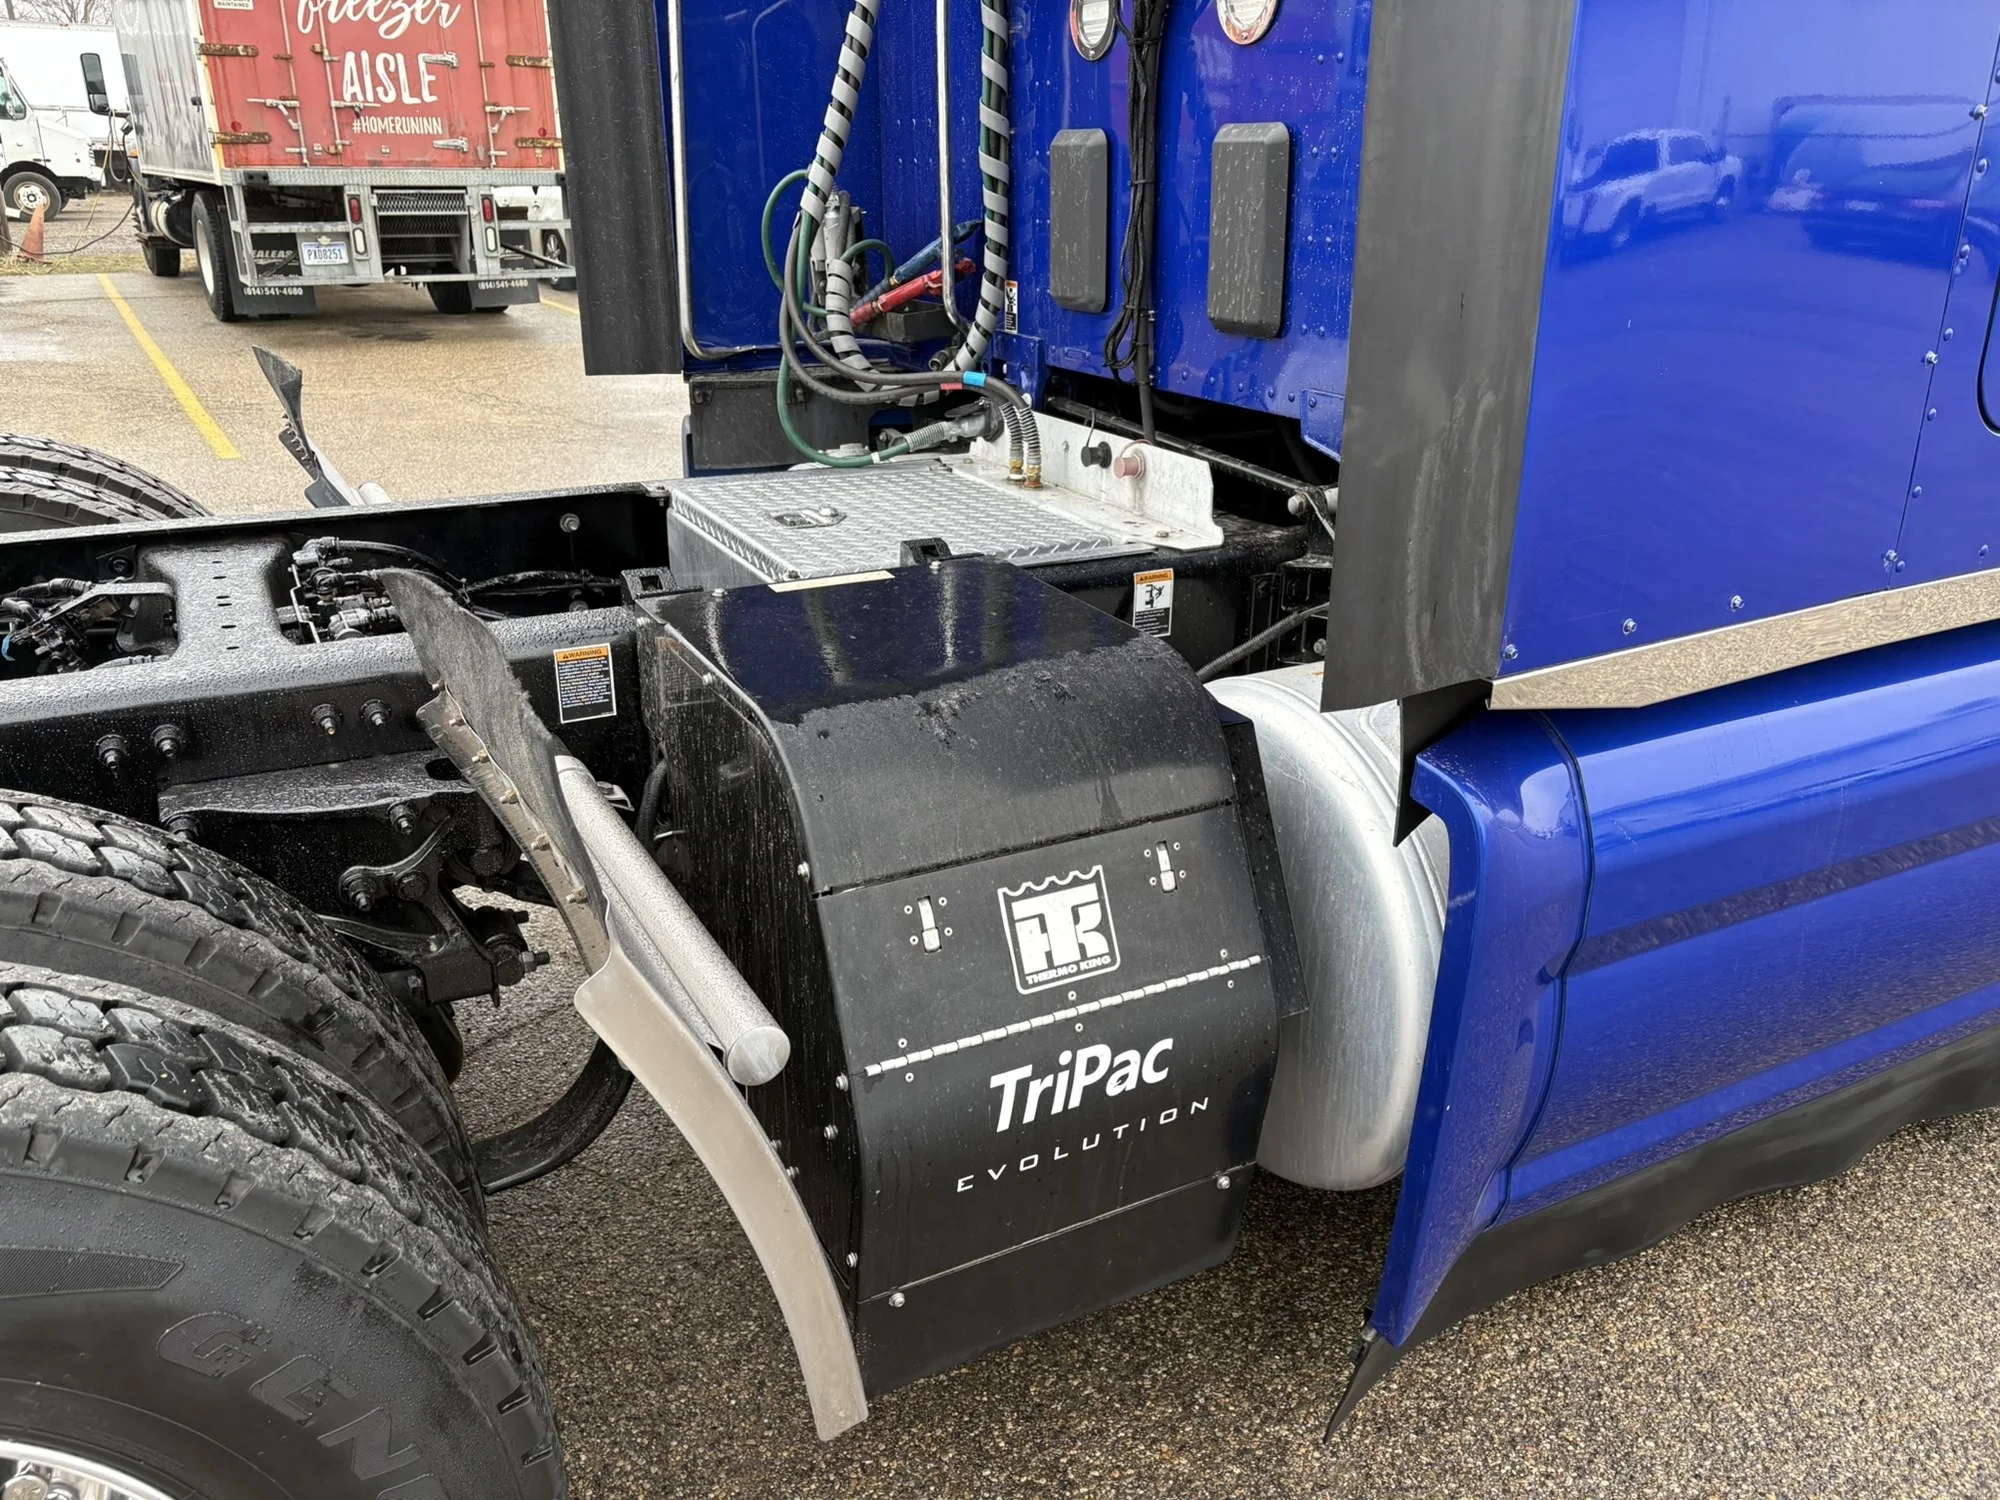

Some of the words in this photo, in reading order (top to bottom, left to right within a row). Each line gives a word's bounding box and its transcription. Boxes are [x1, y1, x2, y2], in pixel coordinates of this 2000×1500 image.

[343, 50, 438, 104] AISLE
[352, 116, 443, 135] #HOMERUNINN
[569, 649, 602, 658] WARNING
[1025, 963, 1078, 985] THERMO
[1079, 955, 1111, 971] KING
[989, 1038, 1174, 1132] TriPac
[957, 1097, 1209, 1193] EVOLUTION
